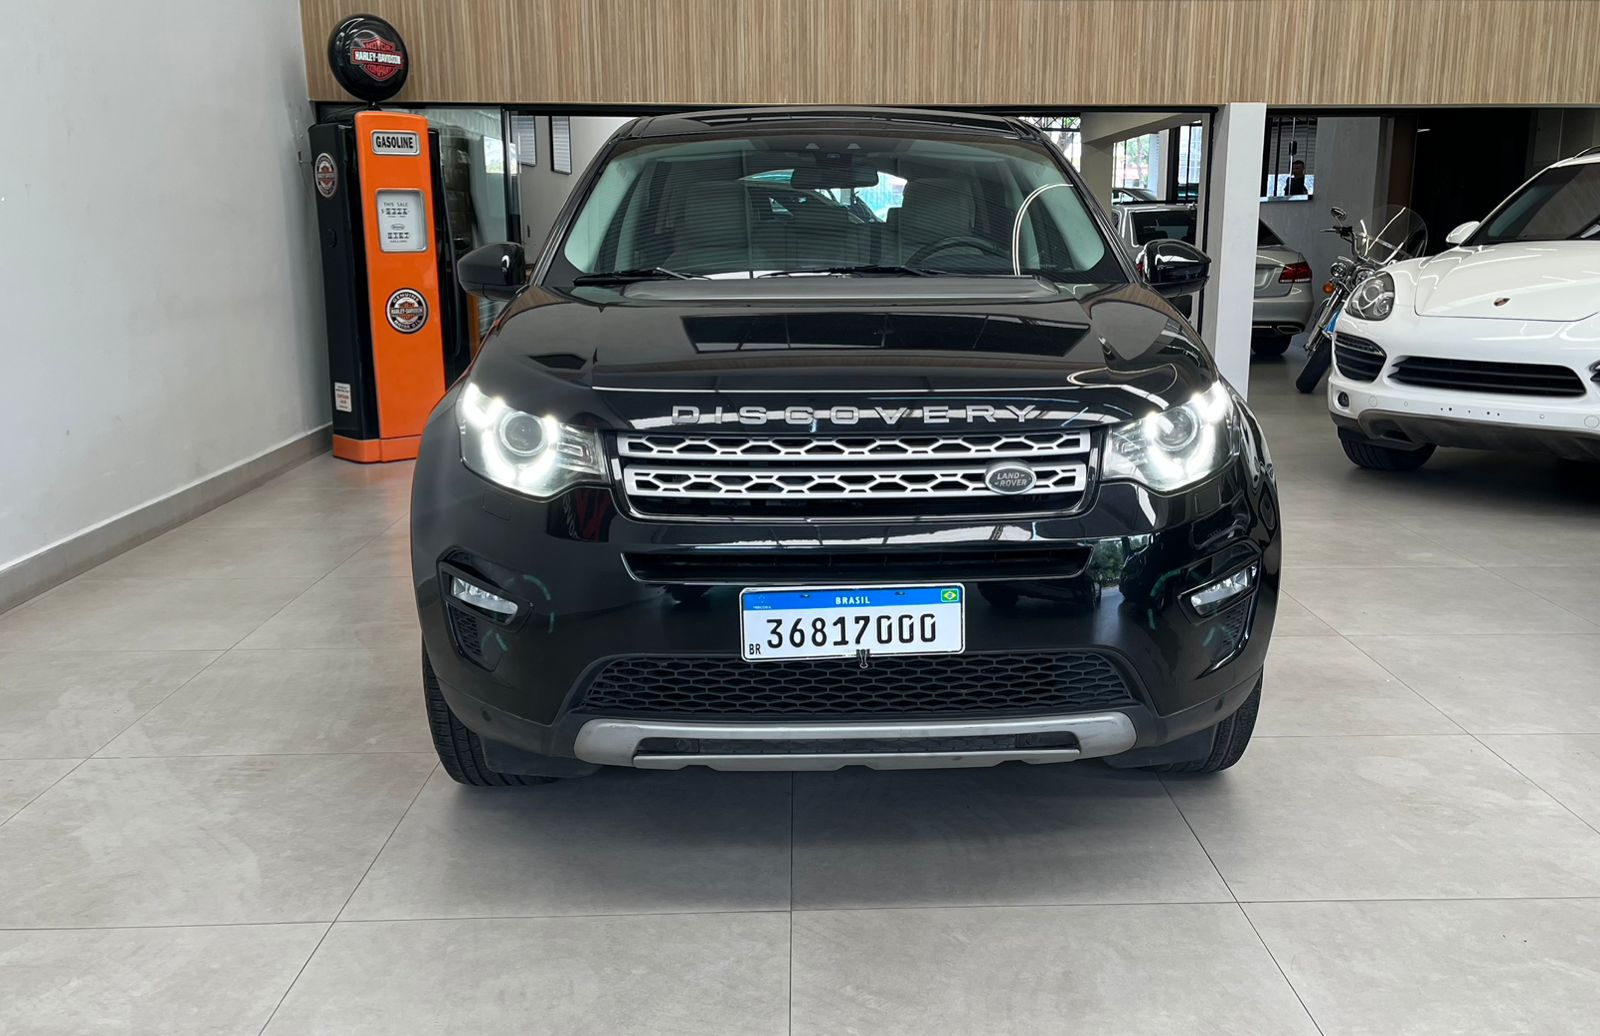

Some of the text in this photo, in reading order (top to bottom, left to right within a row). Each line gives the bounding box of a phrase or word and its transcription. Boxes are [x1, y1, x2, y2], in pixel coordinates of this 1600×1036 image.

[375, 136, 414, 148] GASOLINE
[672, 404, 1036, 425] DISCOVERY
[835, 596, 871, 605] BRASIL
[766, 613, 937, 649] 36817000
[748, 643, 761, 655] BR
